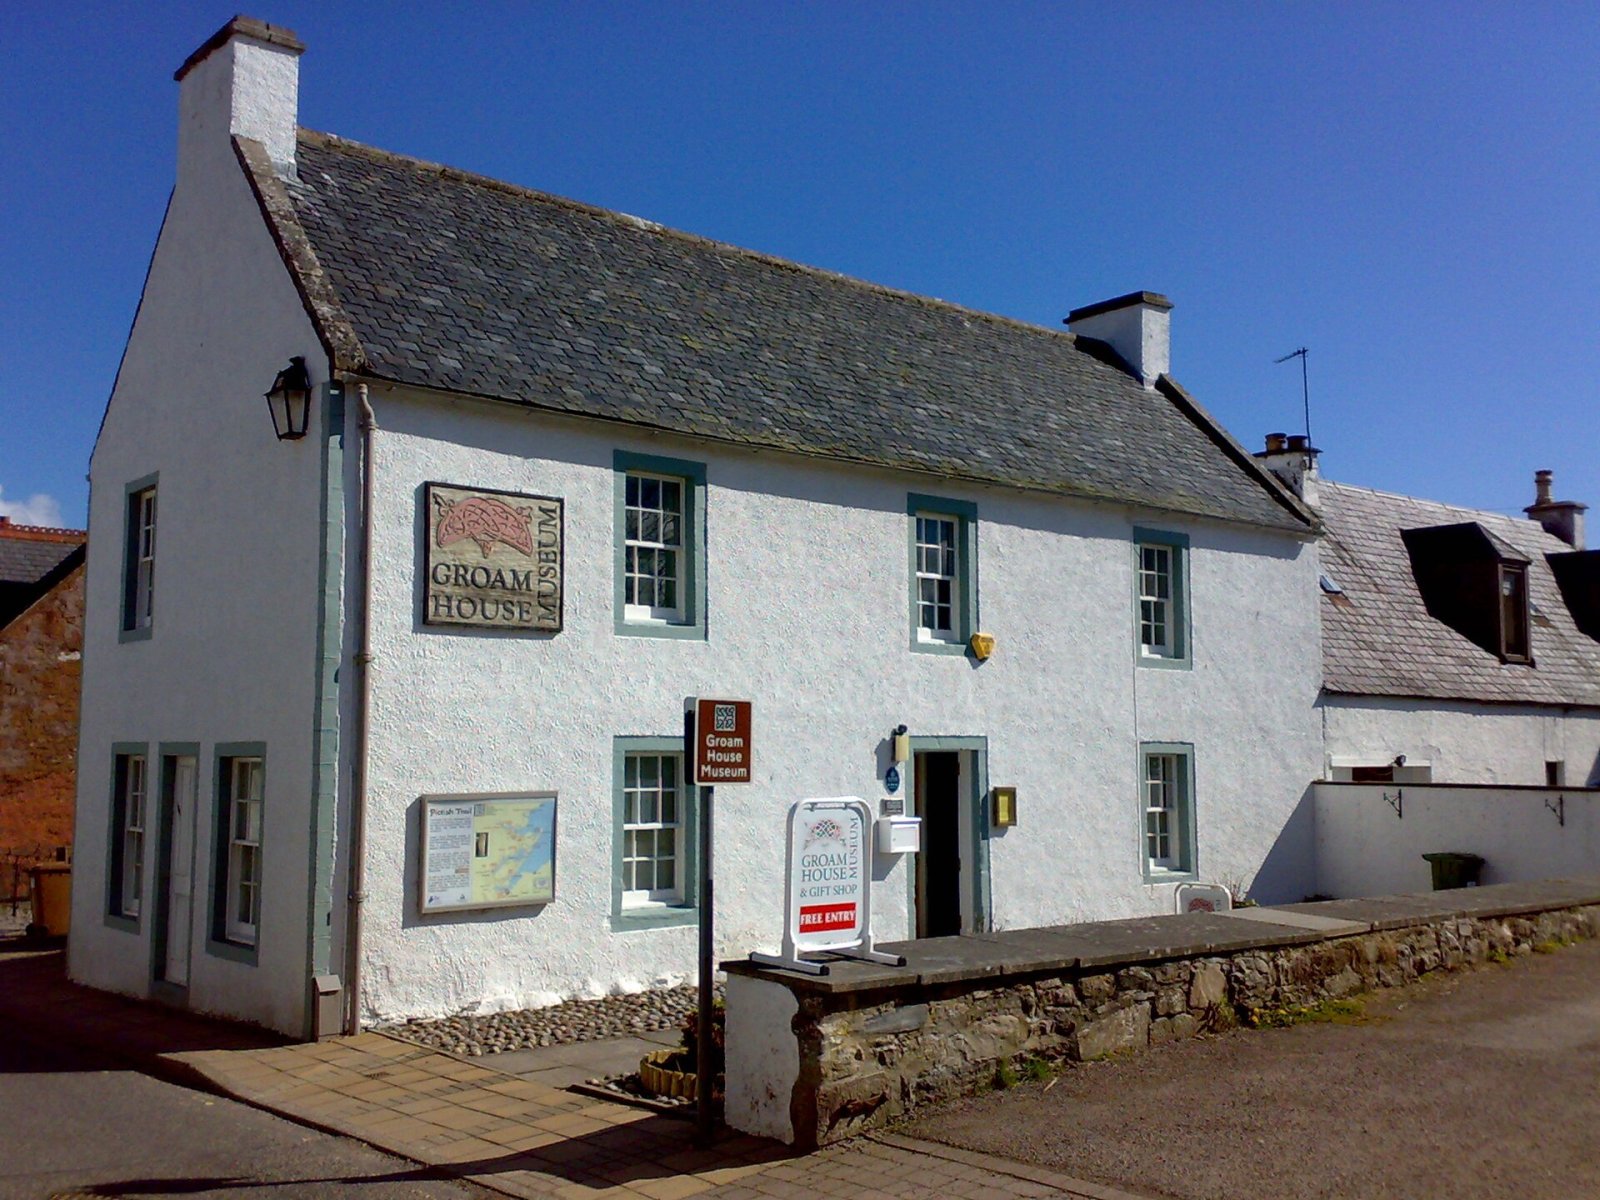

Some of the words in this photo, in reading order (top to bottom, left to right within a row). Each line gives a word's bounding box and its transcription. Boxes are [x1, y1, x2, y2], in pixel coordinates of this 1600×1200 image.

[537, 505, 558, 623] MUSEUM
[432, 563, 533, 592] GROAM
[431, 594, 533, 623] HOUSE
[706, 734, 743, 747] Groam
[707, 750, 743, 762] House
[701, 764, 747, 777] Museum
[849, 816, 859, 879] MUSEUM
[801, 853, 847, 867] GROAM
[801, 867, 847, 882] HOUSE
[800, 888, 808, 898] &
[809, 886, 830, 898] GIFT
[833, 885, 857, 896] SHOP
[800, 913, 824, 925] FREE
[825, 910, 856, 923] ENTRY
